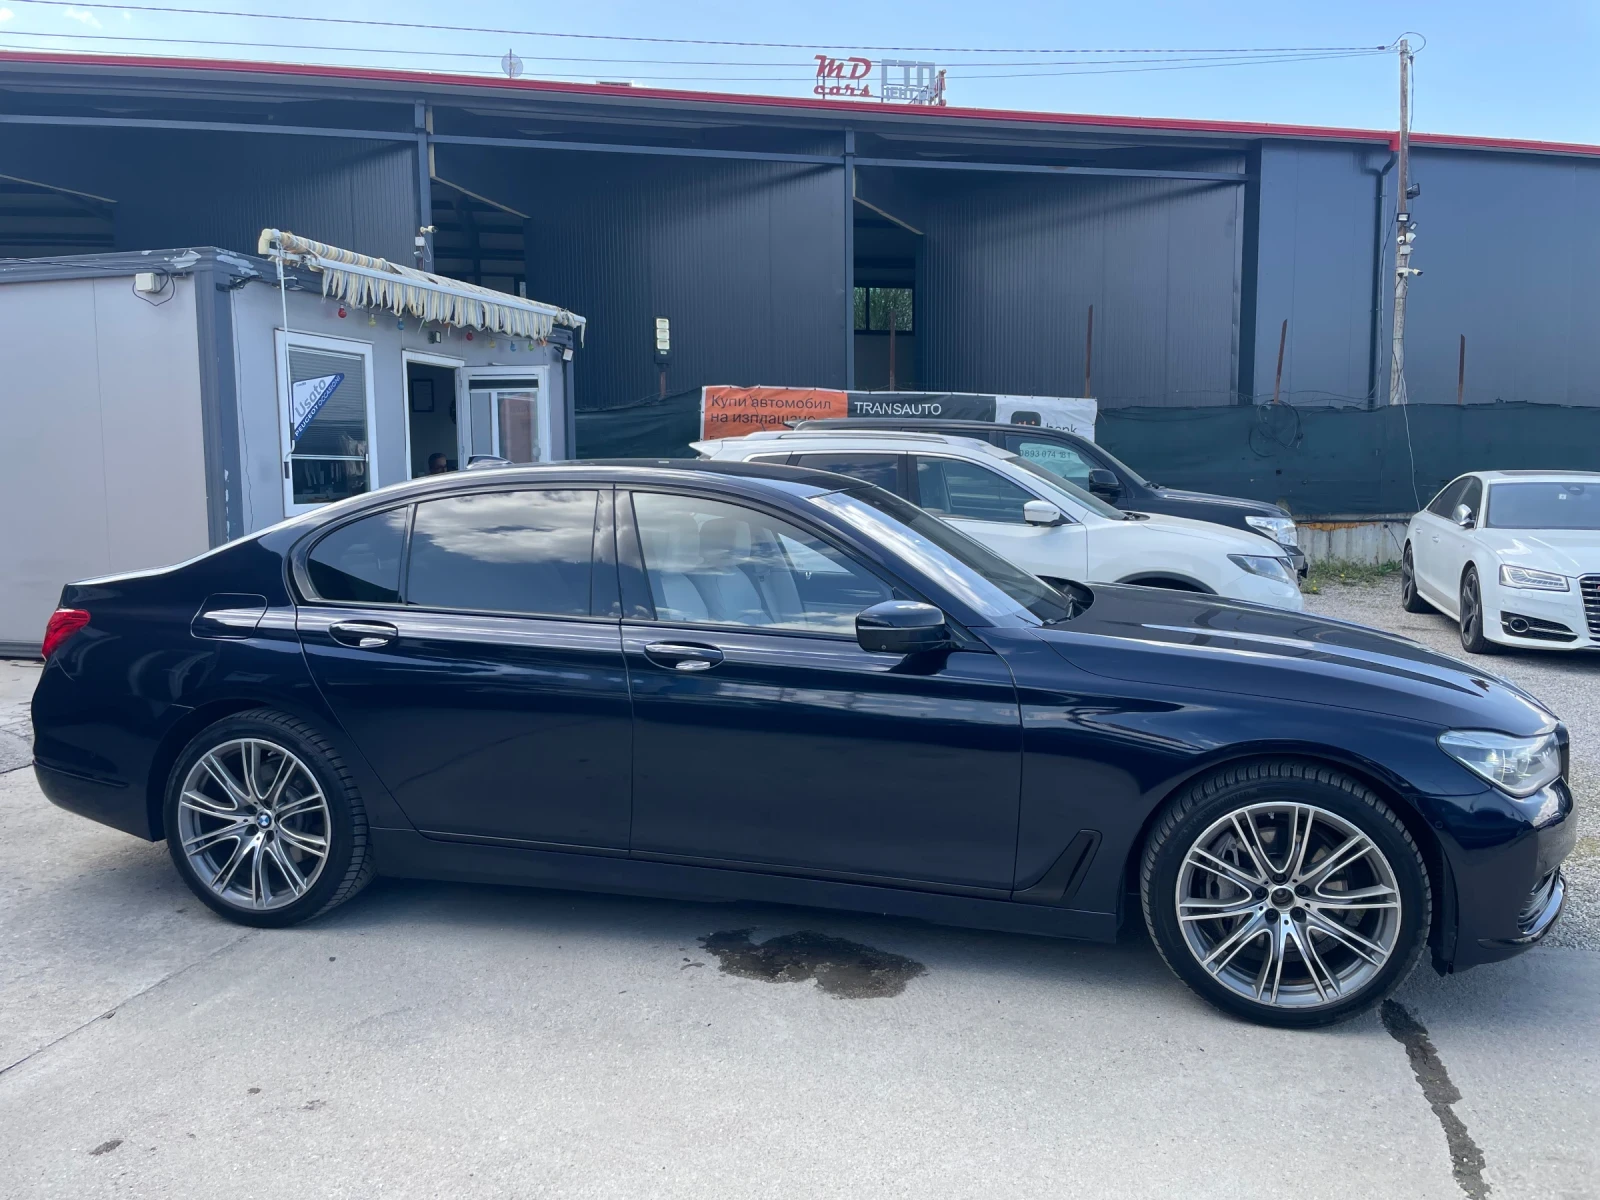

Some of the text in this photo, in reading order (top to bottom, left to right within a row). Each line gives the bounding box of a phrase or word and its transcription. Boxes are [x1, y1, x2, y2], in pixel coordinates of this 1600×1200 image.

[295, 379, 326, 417] Usato
[711, 394, 832, 410] Купи автомобил
[853, 401, 942, 416] TRANSAUTO
[294, 405, 319, 437] PEUGEOT
[711, 413, 728, 423] на
